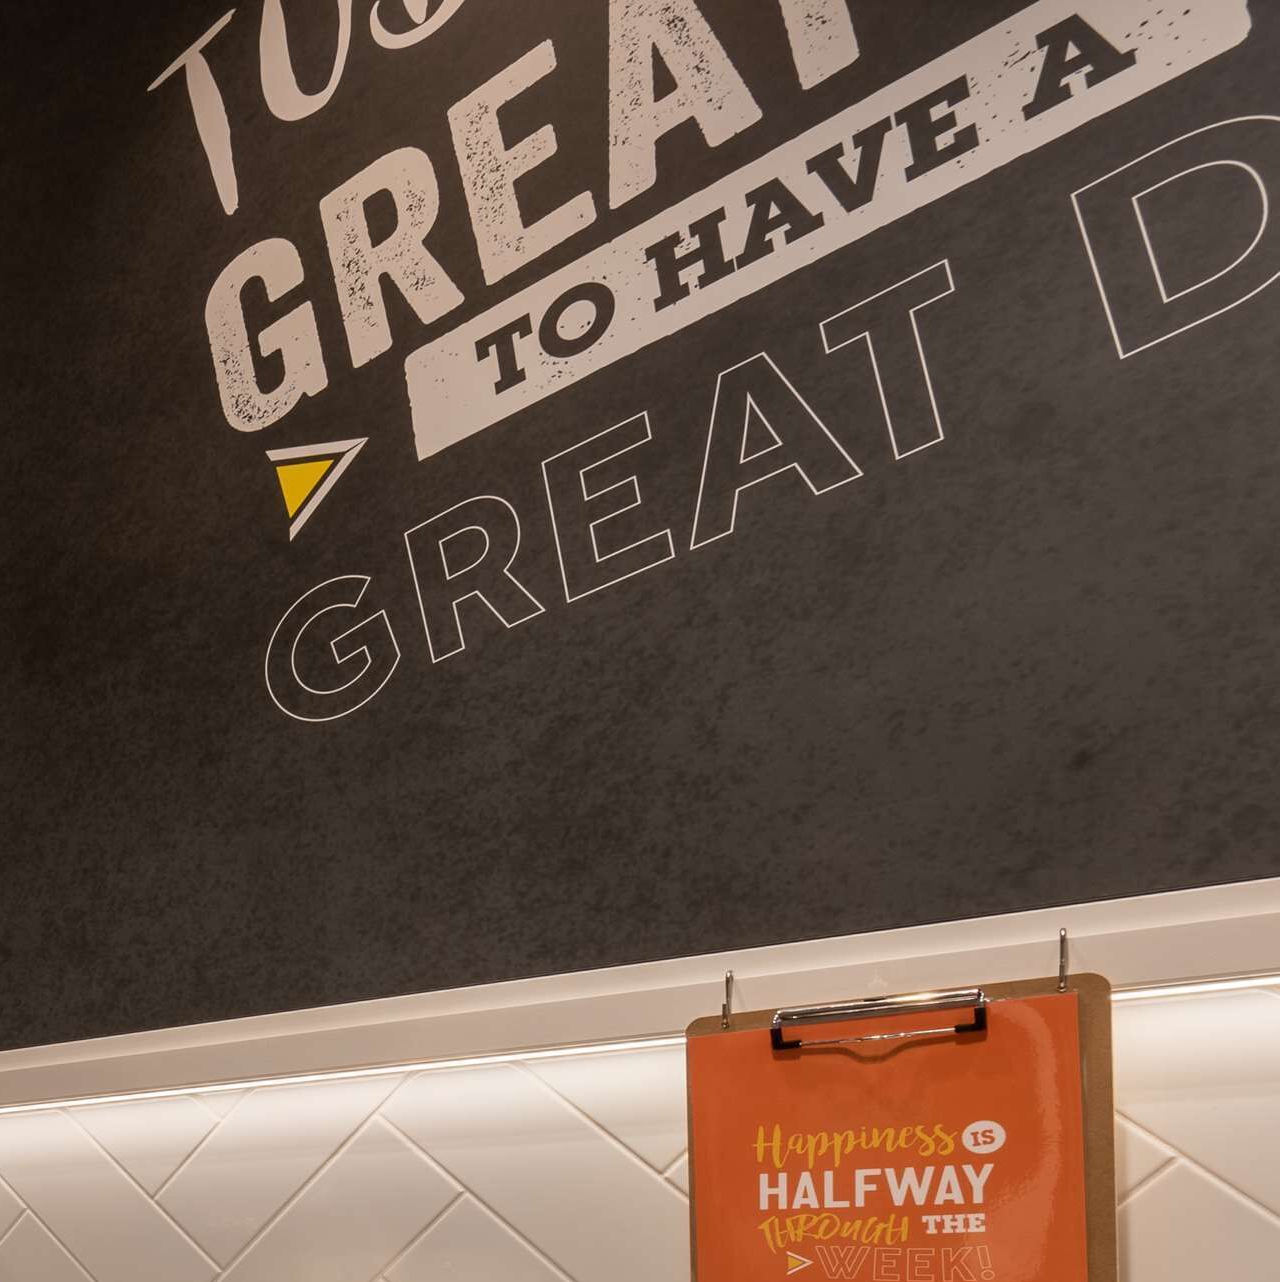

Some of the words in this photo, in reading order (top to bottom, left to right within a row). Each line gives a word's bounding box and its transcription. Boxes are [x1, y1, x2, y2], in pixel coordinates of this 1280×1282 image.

[474, 281, 616, 396] TO
[644, 74, 980, 312] HAVE
[1020, 13, 1138, 120] A
[265, 259, 955, 722] GREAT
[753, 1123, 959, 1169] Happiness
[971, 1128, 996, 1147] IS
[758, 1164, 995, 1210] HALFWAY
[921, 1213, 986, 1235] THE
[814, 1246, 996, 1282] WEEK!
